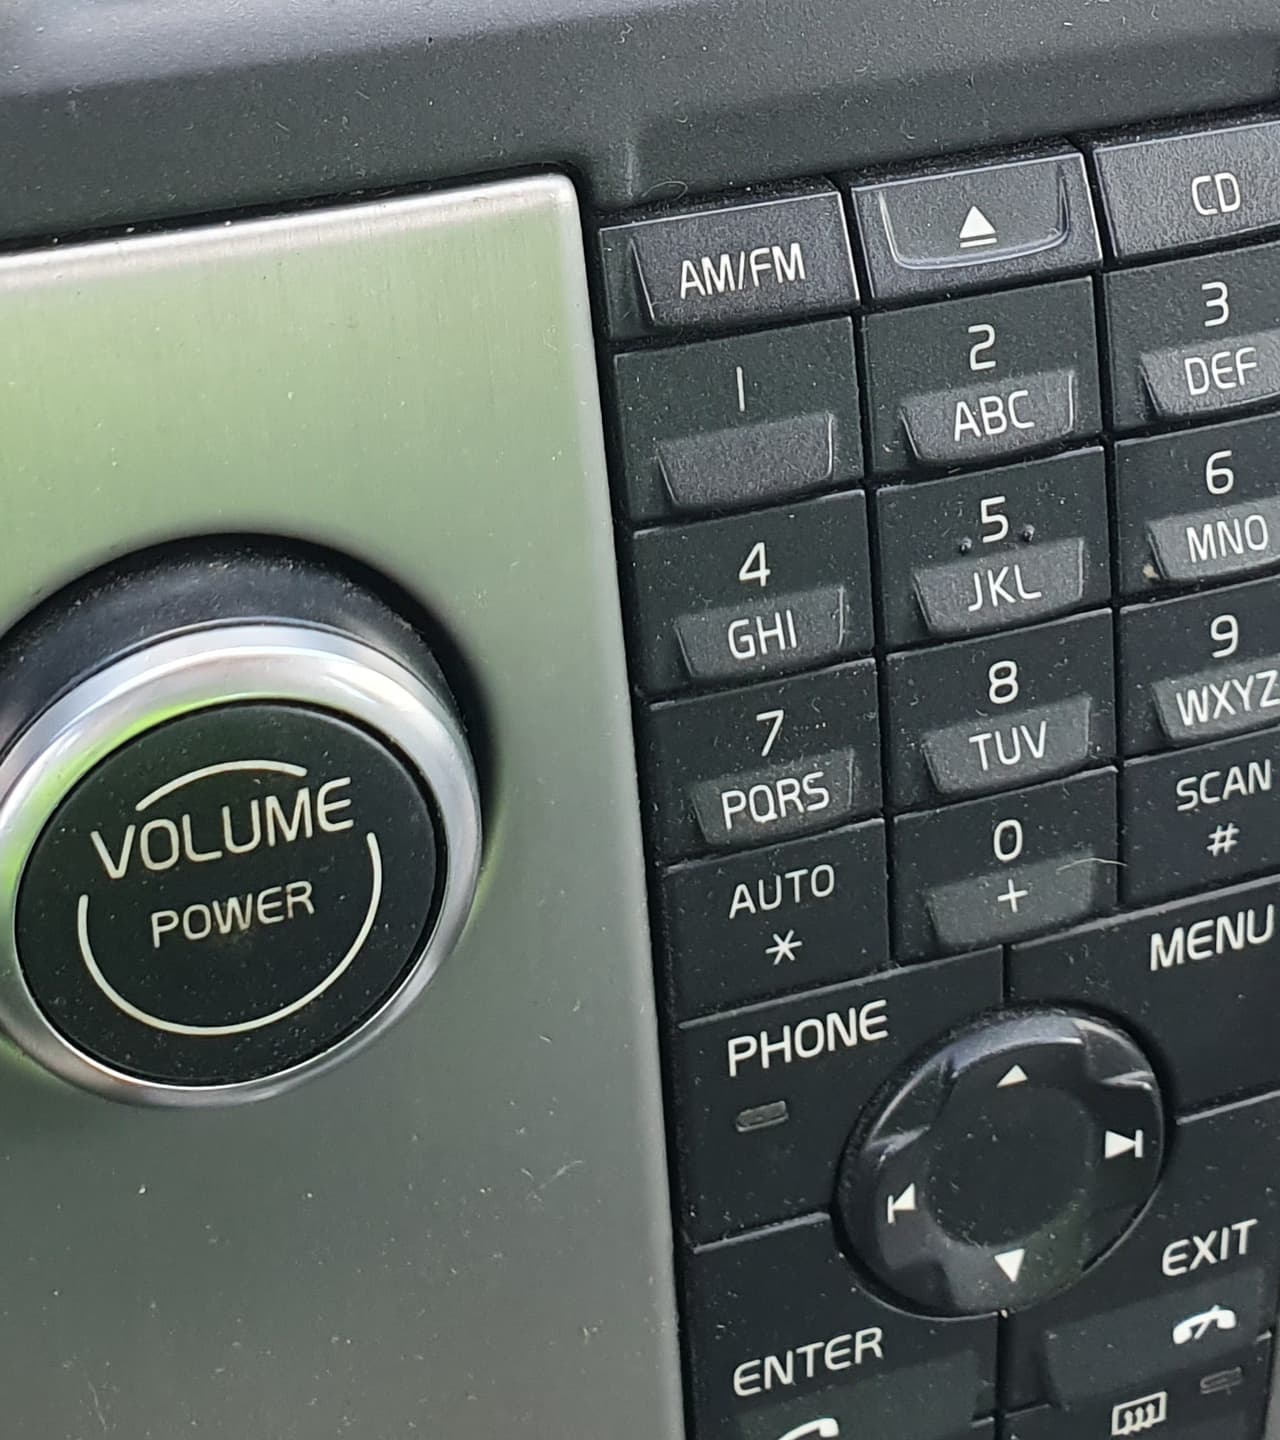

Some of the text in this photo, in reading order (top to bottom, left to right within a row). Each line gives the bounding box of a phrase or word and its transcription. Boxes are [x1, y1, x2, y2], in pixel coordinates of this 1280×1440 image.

[1190, 171, 1241, 217] CD
[677, 242, 807, 300] AM/FM
[1201, 281, 1231, 328] 3
[966, 323, 997, 371] 2
[1184, 346, 1259, 397] DEF
[952, 389, 1035, 442] ABC
[1204, 449, 1234, 495] 6
[980, 496, 1009, 543] 5
[1185, 514, 1269, 564] MNO
[738, 541, 771, 588] 4
[967, 564, 1042, 613] JKL
[727, 610, 798, 660] GHI
[1209, 614, 1239, 658] 9
[986, 660, 1020, 706] 8
[754, 709, 784, 757] 7
[968, 720, 1048, 772] TUV
[720, 771, 830, 830] PQRS
[1175, 758, 1273, 812] SCAN
[90, 776, 355, 880] VOLUME
[992, 818, 1023, 862] 0
[151, 880, 316, 949] POWER
[728, 863, 836, 920] AUTO
[1149, 903, 1276, 972] MENU
[727, 999, 889, 1077] PHONE
[1160, 1218, 1259, 1277] EXIT
[732, 1326, 884, 1398] ENTER
